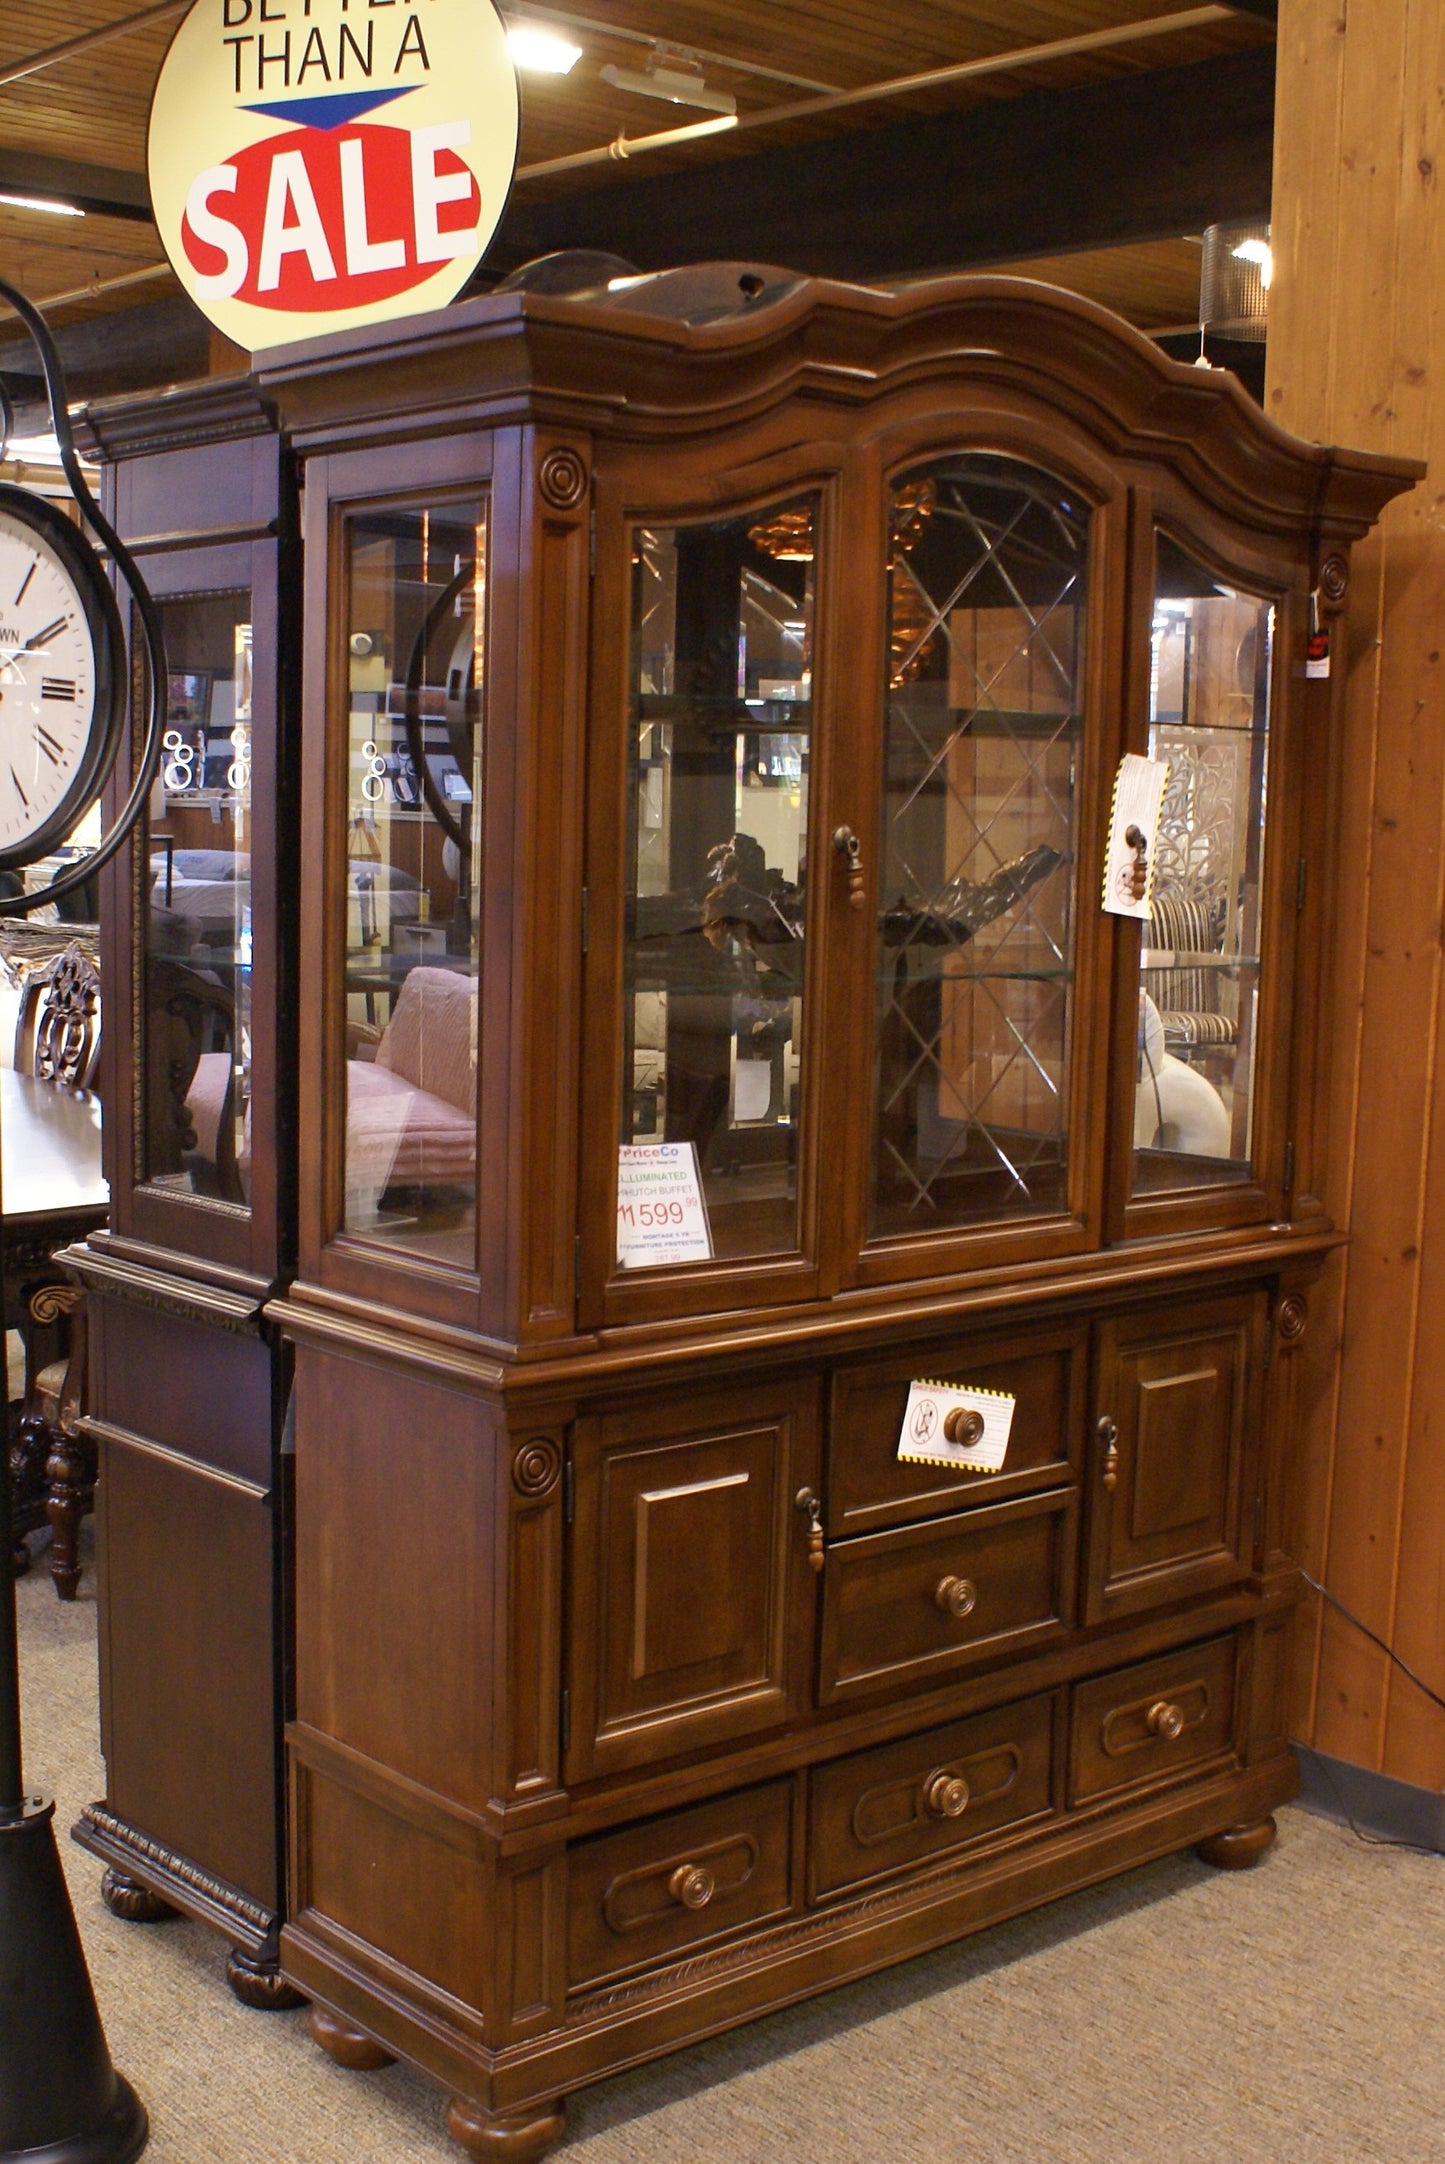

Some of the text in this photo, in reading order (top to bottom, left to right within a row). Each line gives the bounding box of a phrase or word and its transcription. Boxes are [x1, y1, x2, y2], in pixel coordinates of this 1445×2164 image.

[223, 15, 431, 93] THAN A
[185, 119, 479, 302] SALE
[659, 1184, 693, 1195] BUFFET
[664, 1239, 705, 1248] PROTECTION
